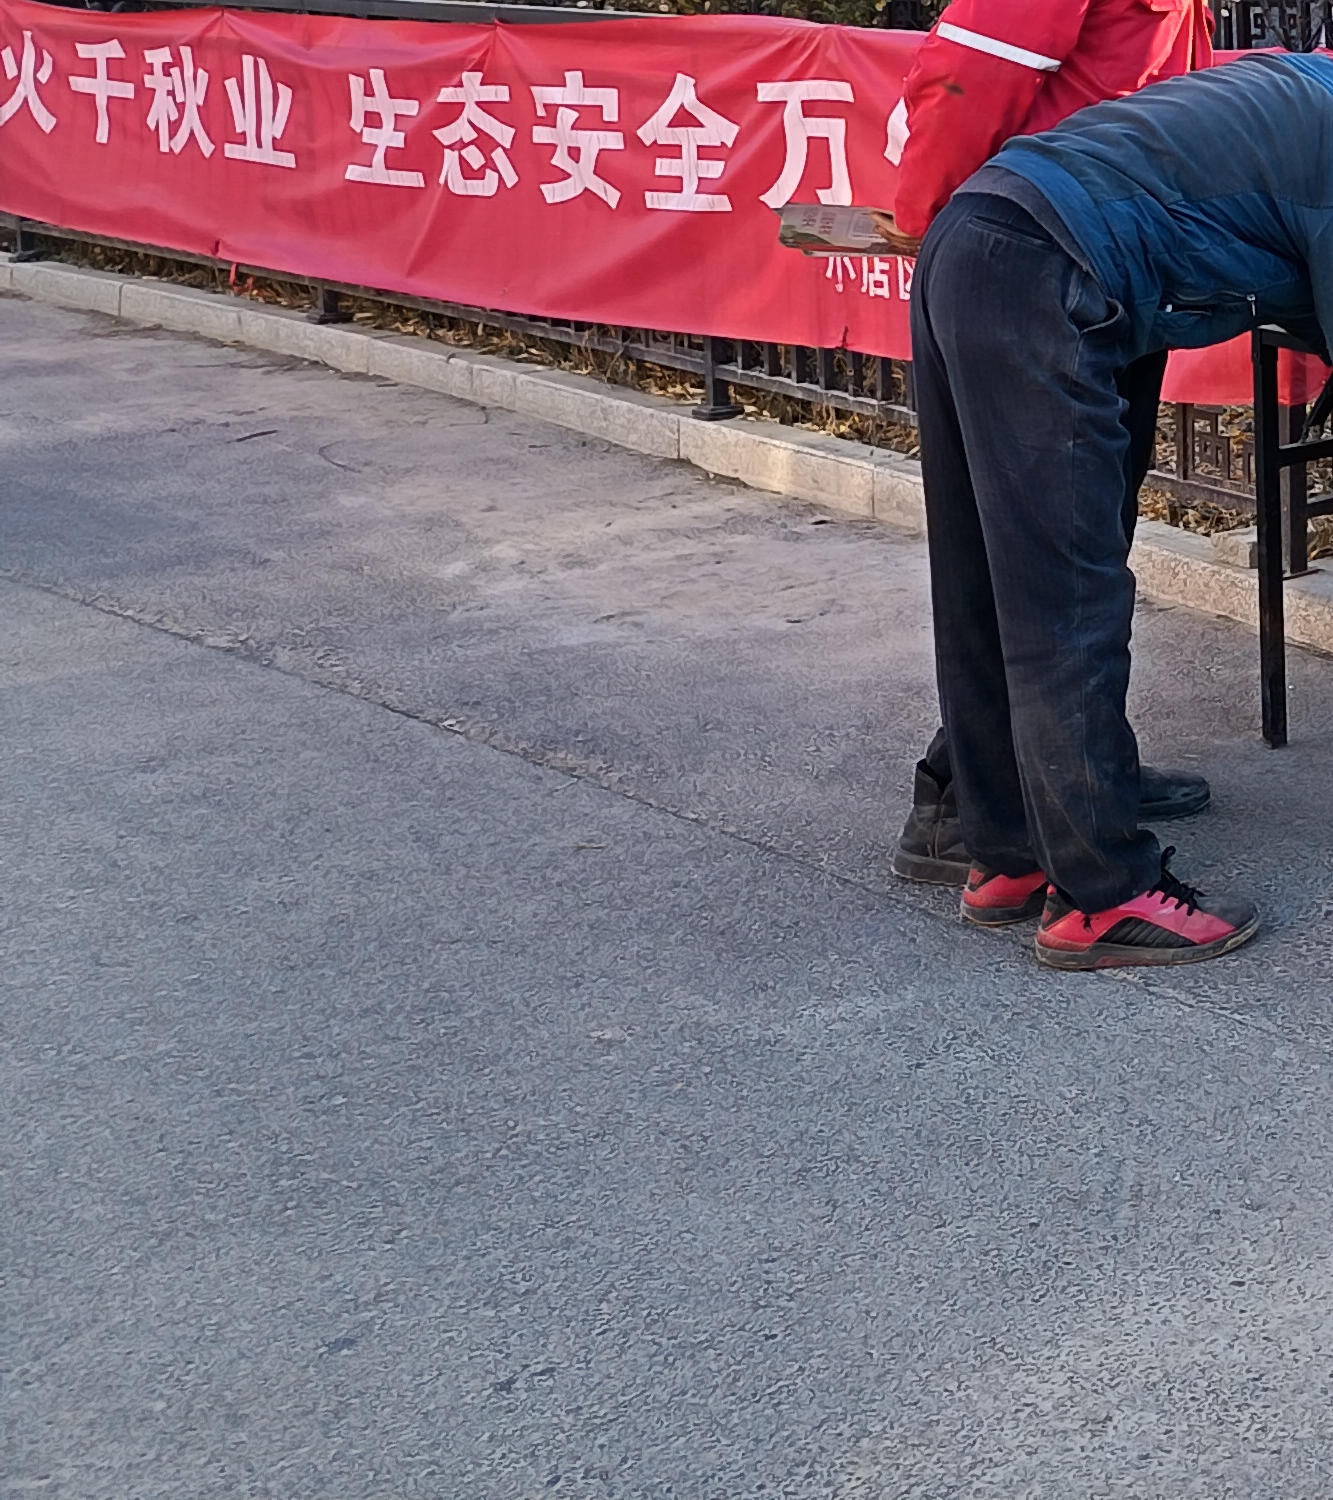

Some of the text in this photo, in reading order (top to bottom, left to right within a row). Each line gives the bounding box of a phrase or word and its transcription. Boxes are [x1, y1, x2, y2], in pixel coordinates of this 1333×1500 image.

[0, 29, 910, 212] 火千秋业 生态安全万
